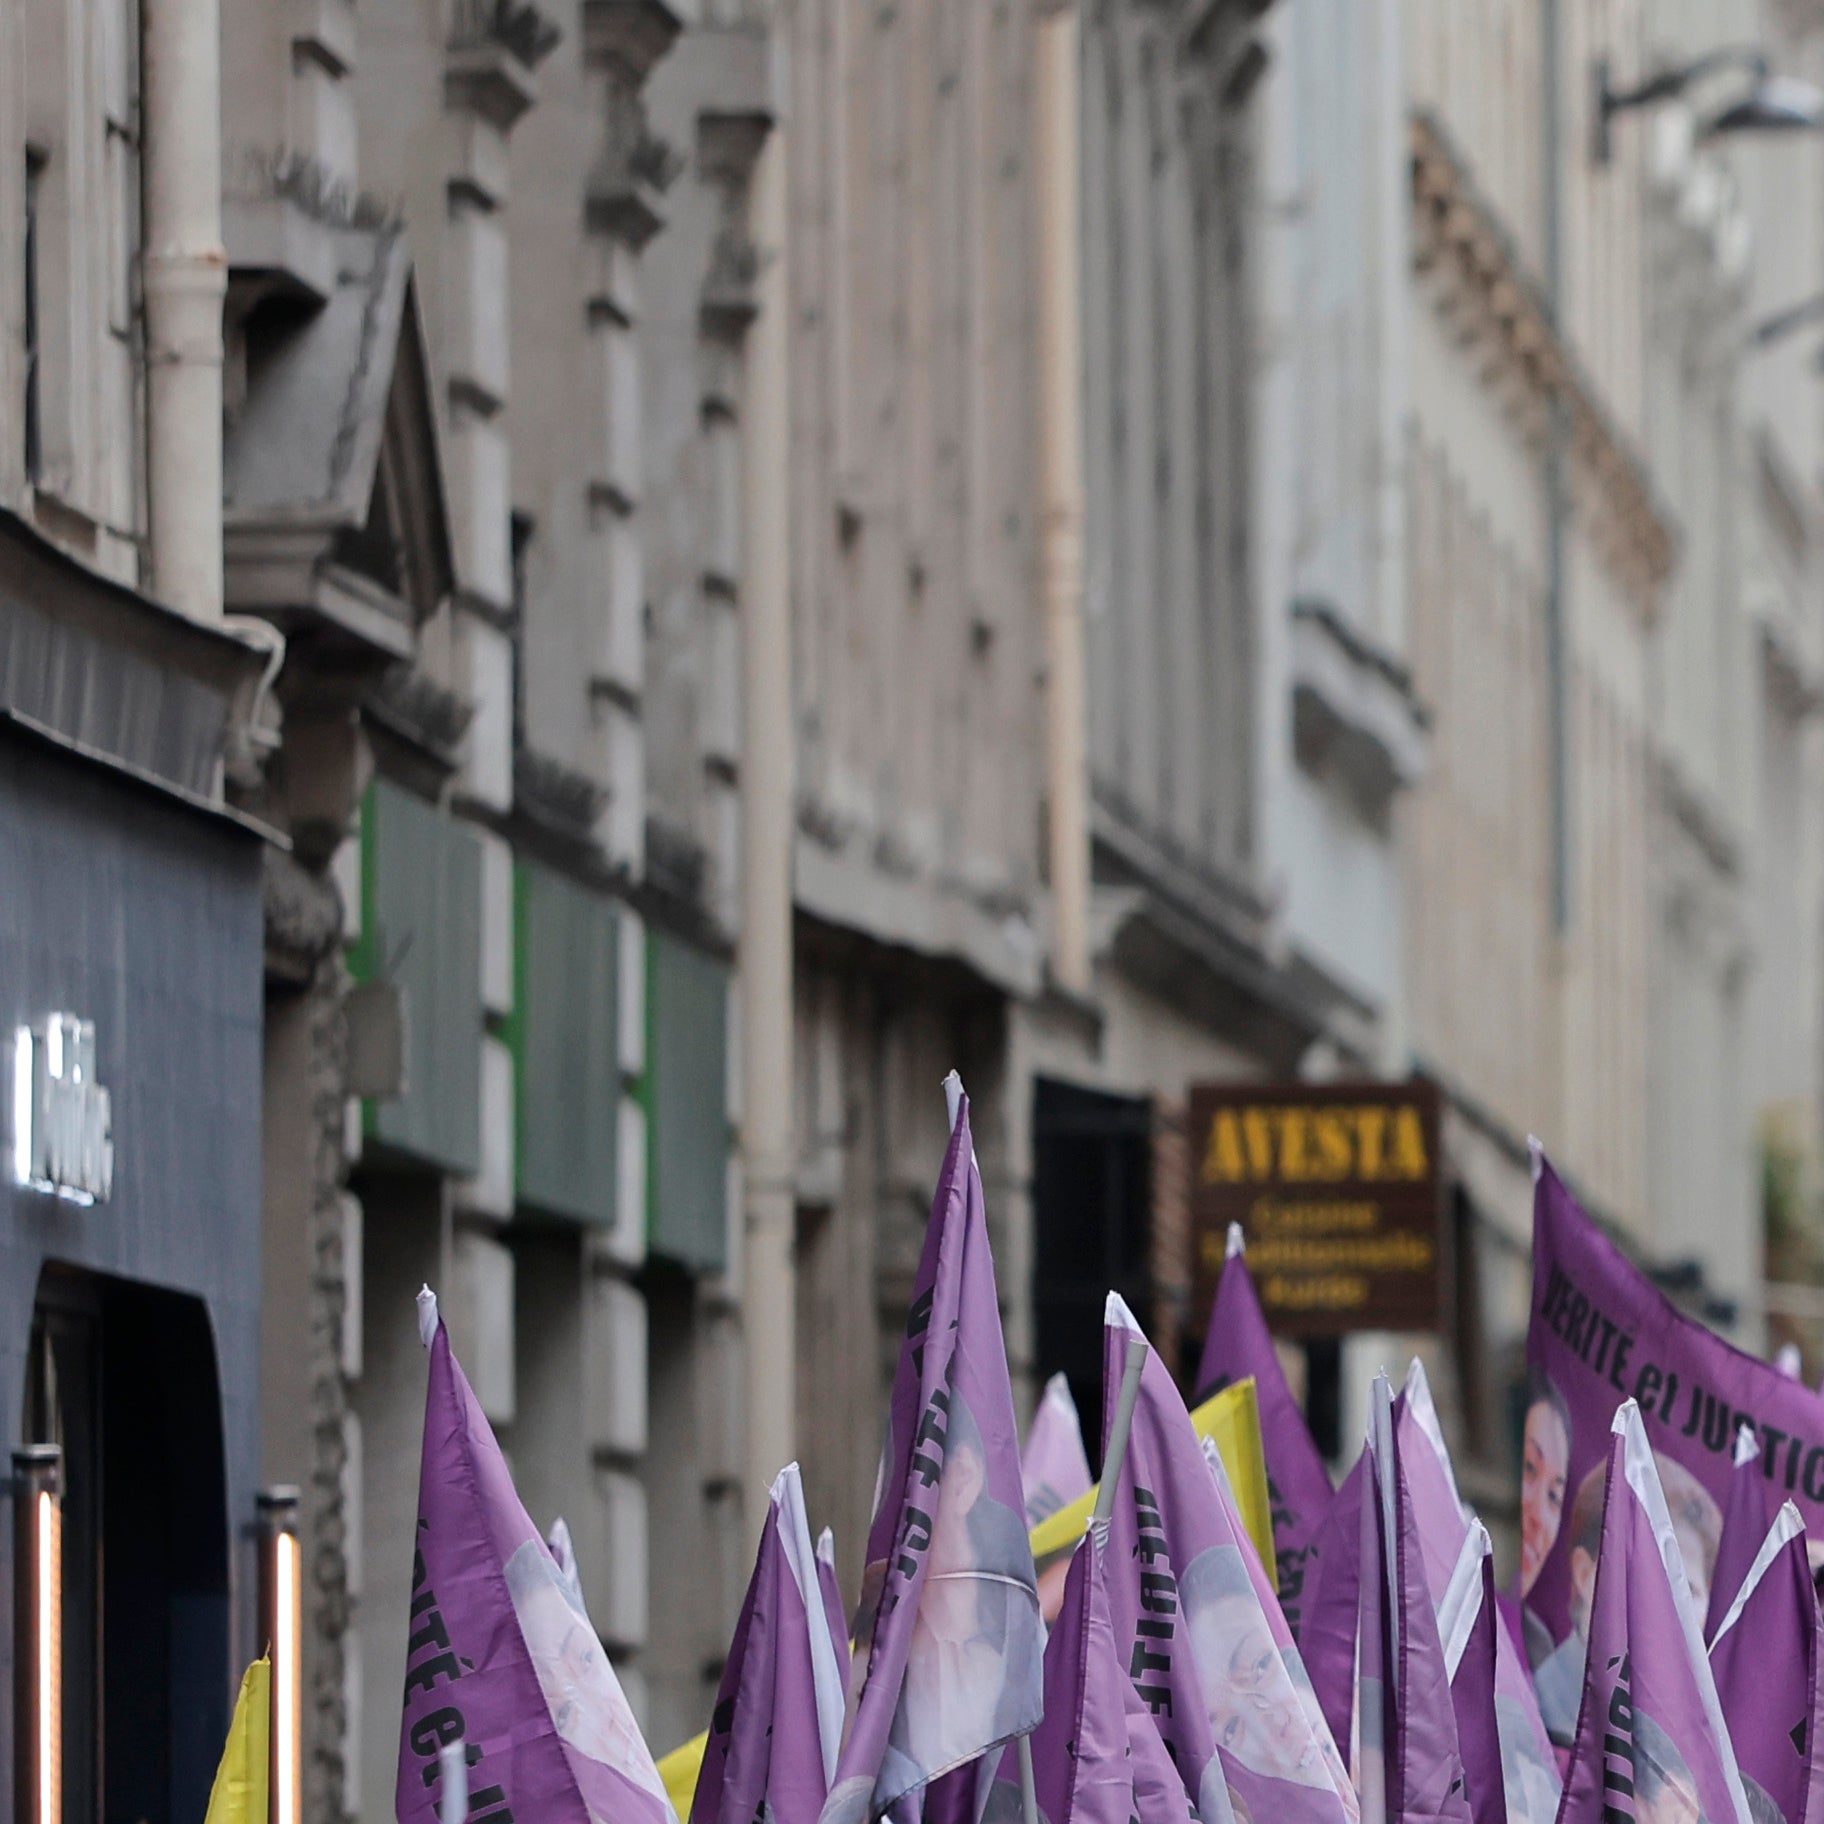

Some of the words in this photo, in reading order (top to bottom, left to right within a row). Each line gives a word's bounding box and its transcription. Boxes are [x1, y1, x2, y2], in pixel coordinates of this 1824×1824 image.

[1203, 1104, 1429, 1183] AVESTA
[1540, 1263, 1636, 1394] VÉRITÉ
[1635, 1361, 1679, 1426] et
